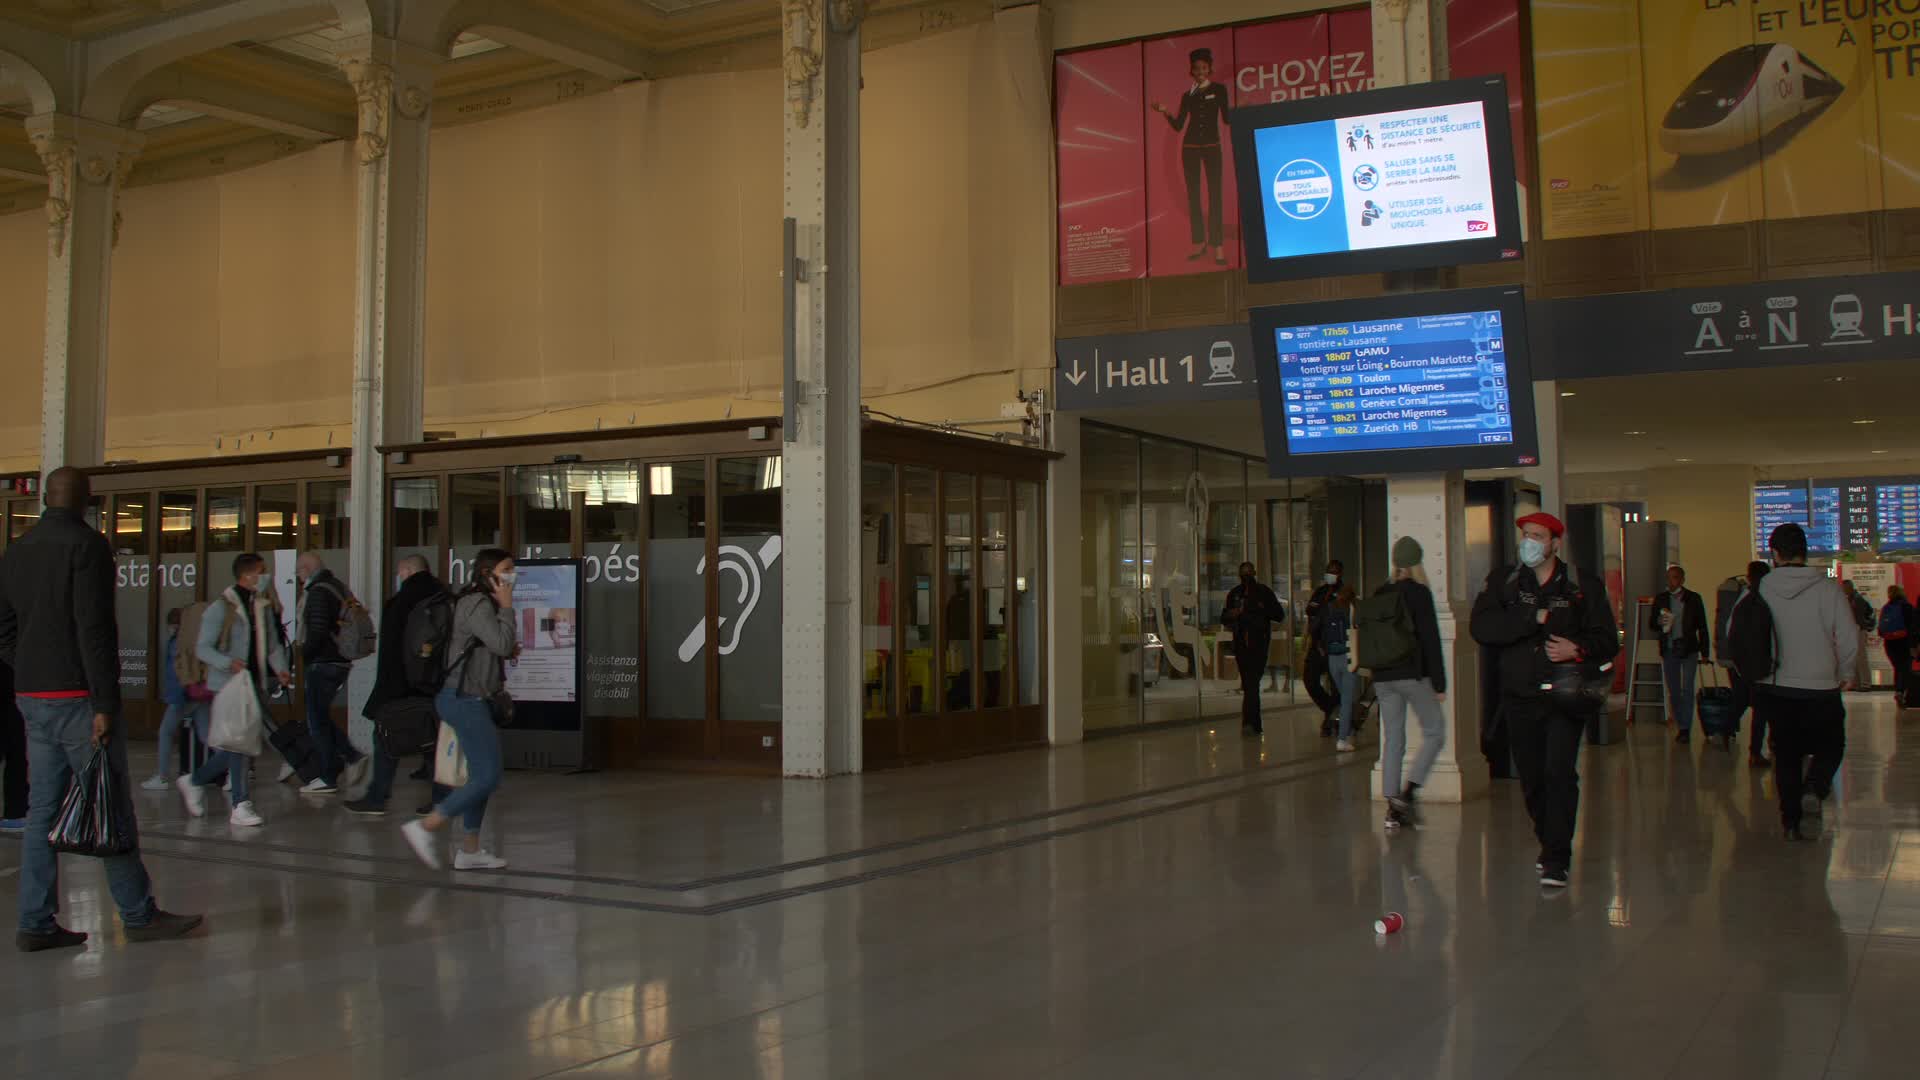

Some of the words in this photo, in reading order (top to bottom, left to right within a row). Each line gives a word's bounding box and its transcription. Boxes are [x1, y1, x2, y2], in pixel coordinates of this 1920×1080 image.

[1758, 10, 1788, 32] ET
[1838, 24, 1856, 48] À
[1237, 51, 1365, 92] CHOYEZ
[1380, 116, 1428, 130] RESPECTER
[1430, 114, 1448, 123] UNE
[1381, 128, 1424, 140] DISTANCE
[1426, 126, 1438, 135] DE
[1440, 120, 1481, 134] SÉCURITÉ
[1384, 158, 1417, 169] SALUER
[1419, 155, 1442, 166] SANS
[1444, 153, 1455, 162] SE
[1297, 168, 1315, 176] TRAIN
[1385, 168, 1417, 179] SERRER
[1419, 166, 1430, 175] LA
[1432, 163, 1456, 174] MAIN
[1277, 187, 1329, 198] RESPONSABLES
[1292, 182, 1312, 190] TOUS
[1389, 198, 1425, 209] UTILISER
[1427, 196, 1444, 205] DES
[1390, 207, 1443, 219] MOUCHOIRS
[1444, 204, 1452, 214] À
[1454, 202, 1483, 213] USAGE
[1468, 222, 1488, 231] SNCF
[1695, 303, 1719, 313] Voie
[1770, 298, 1794, 308] Voie
[1323, 327, 1349, 336] 17h56
[1353, 321, 1403, 335] Lausanne
[1489, 315, 1497, 323] A
[1695, 317, 1724, 349] A
[1739, 310, 1751, 328] à
[1768, 311, 1797, 344] N
[1343, 336, 1388, 346] Lausanne
[1325, 352, 1351, 362] 18h07
[1491, 341, 1500, 349] M
[1107, 358, 1169, 388] Hall
[1179, 354, 1193, 384] 1
[1357, 359, 1384, 372] Loing
[1390, 358, 1428, 369] Bourron
[1430, 354, 1472, 366] Marlotte
[1328, 376, 1352, 385] 18h09
[1358, 373, 1391, 383] Toulon
[1329, 389, 1354, 398] 18h12
[1359, 386, 1397, 396] Laroche
[1399, 382, 1445, 395] Migennes
[1360, 398, 1396, 409] Genève
[1332, 413, 1356, 423] 18h21
[1362, 410, 1400, 420] Laroche
[1401, 407, 1447, 419] Migennes
[1363, 422, 1399, 433] Zuerich
[1404, 421, 1418, 431] HB
[587, 656, 637, 665] Assistenza
[587, 671, 638, 685] viaggiatori
[593, 688, 630, 698] disabili
